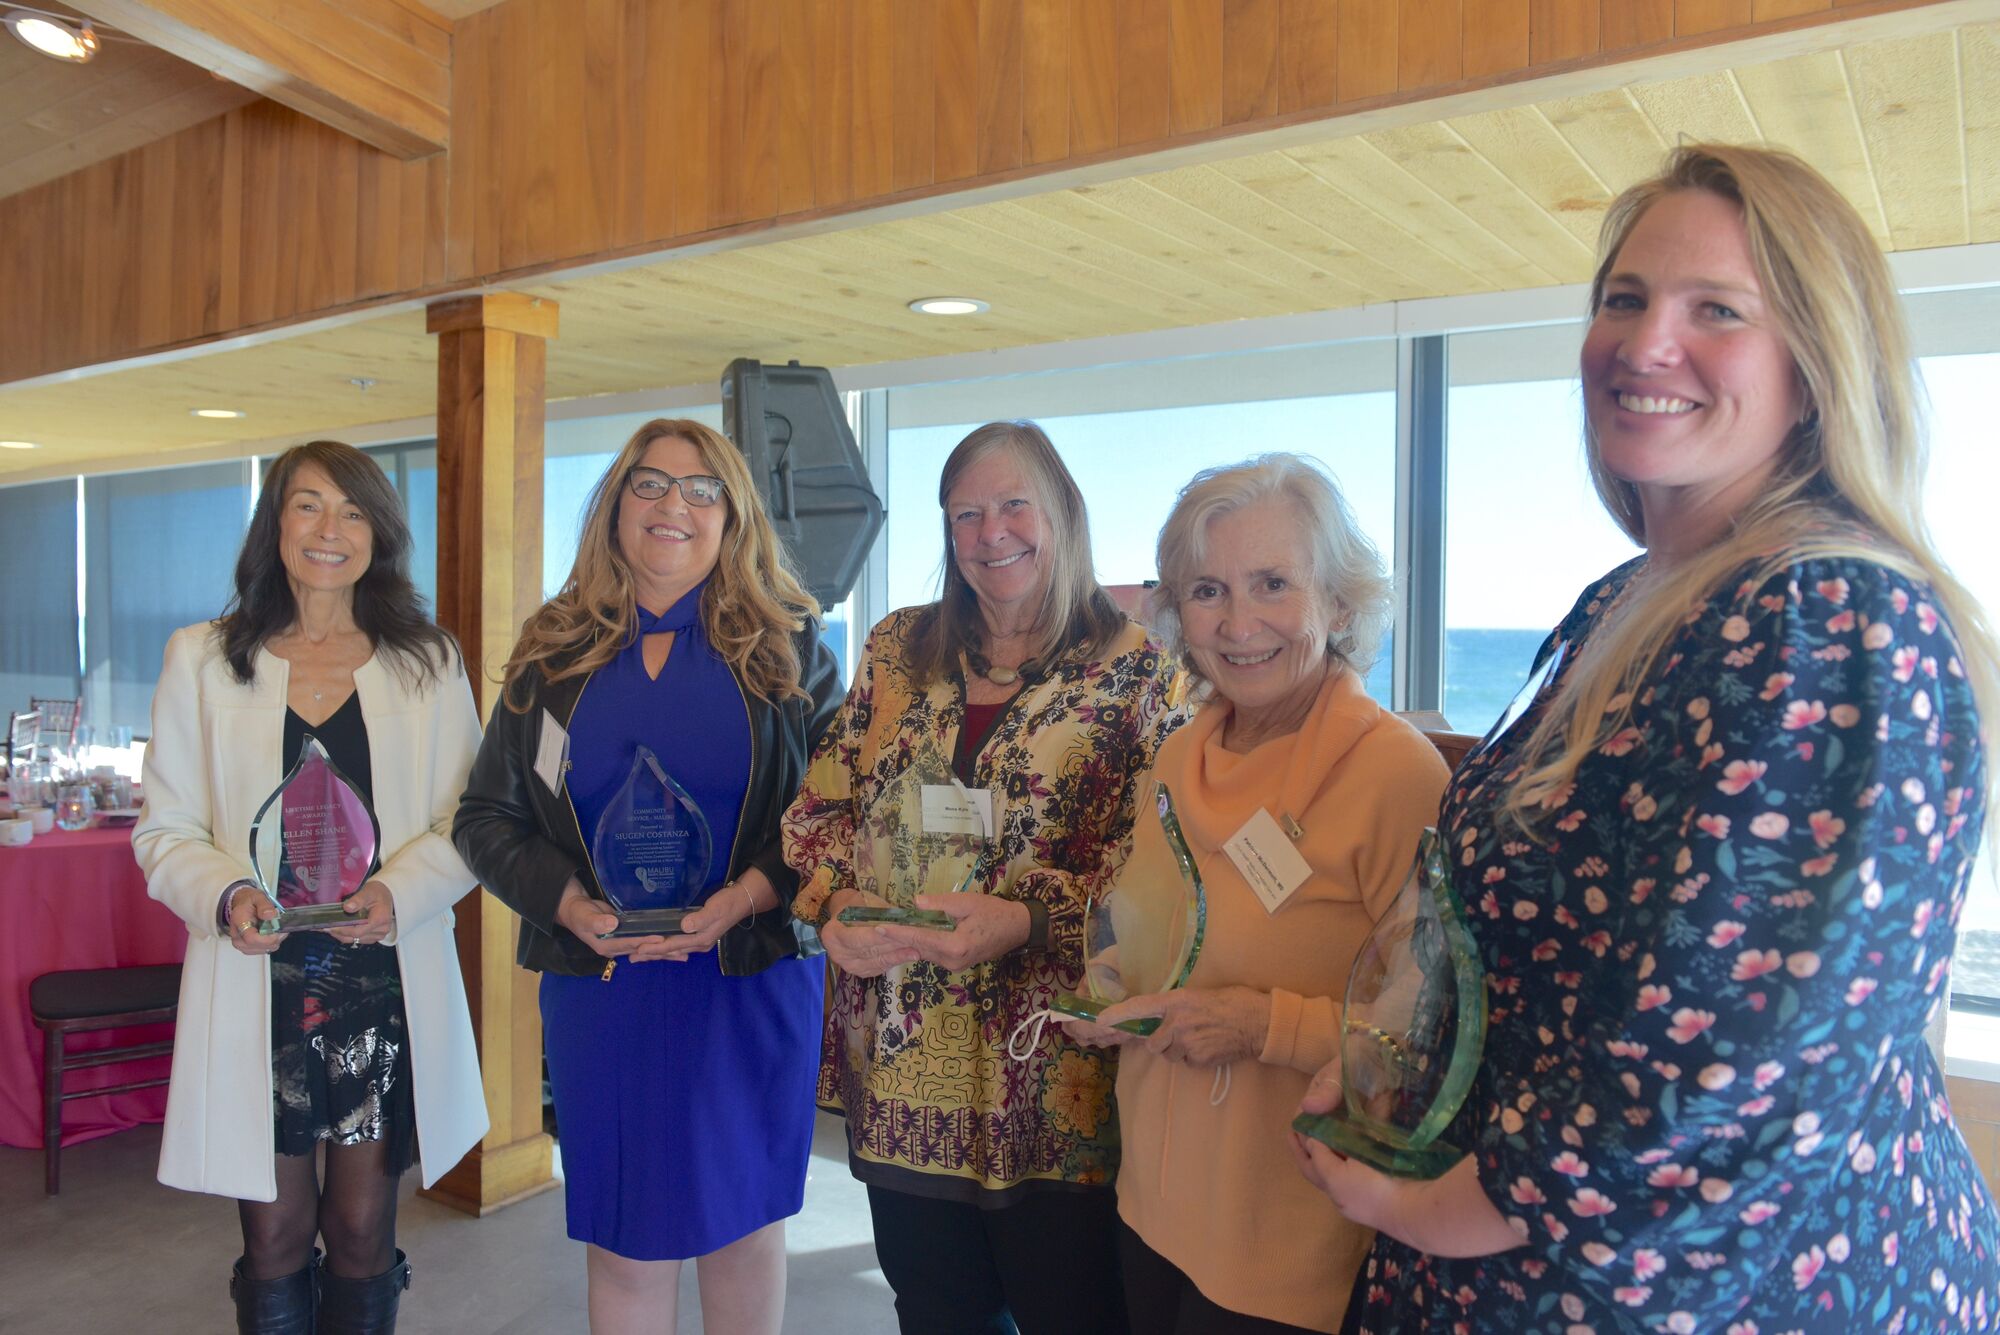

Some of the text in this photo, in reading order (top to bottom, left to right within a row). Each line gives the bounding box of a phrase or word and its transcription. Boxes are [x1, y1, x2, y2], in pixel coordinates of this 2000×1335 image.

[283, 826, 346, 838] ELLEN SHANE
[647, 830, 689, 838] COSTANZA
